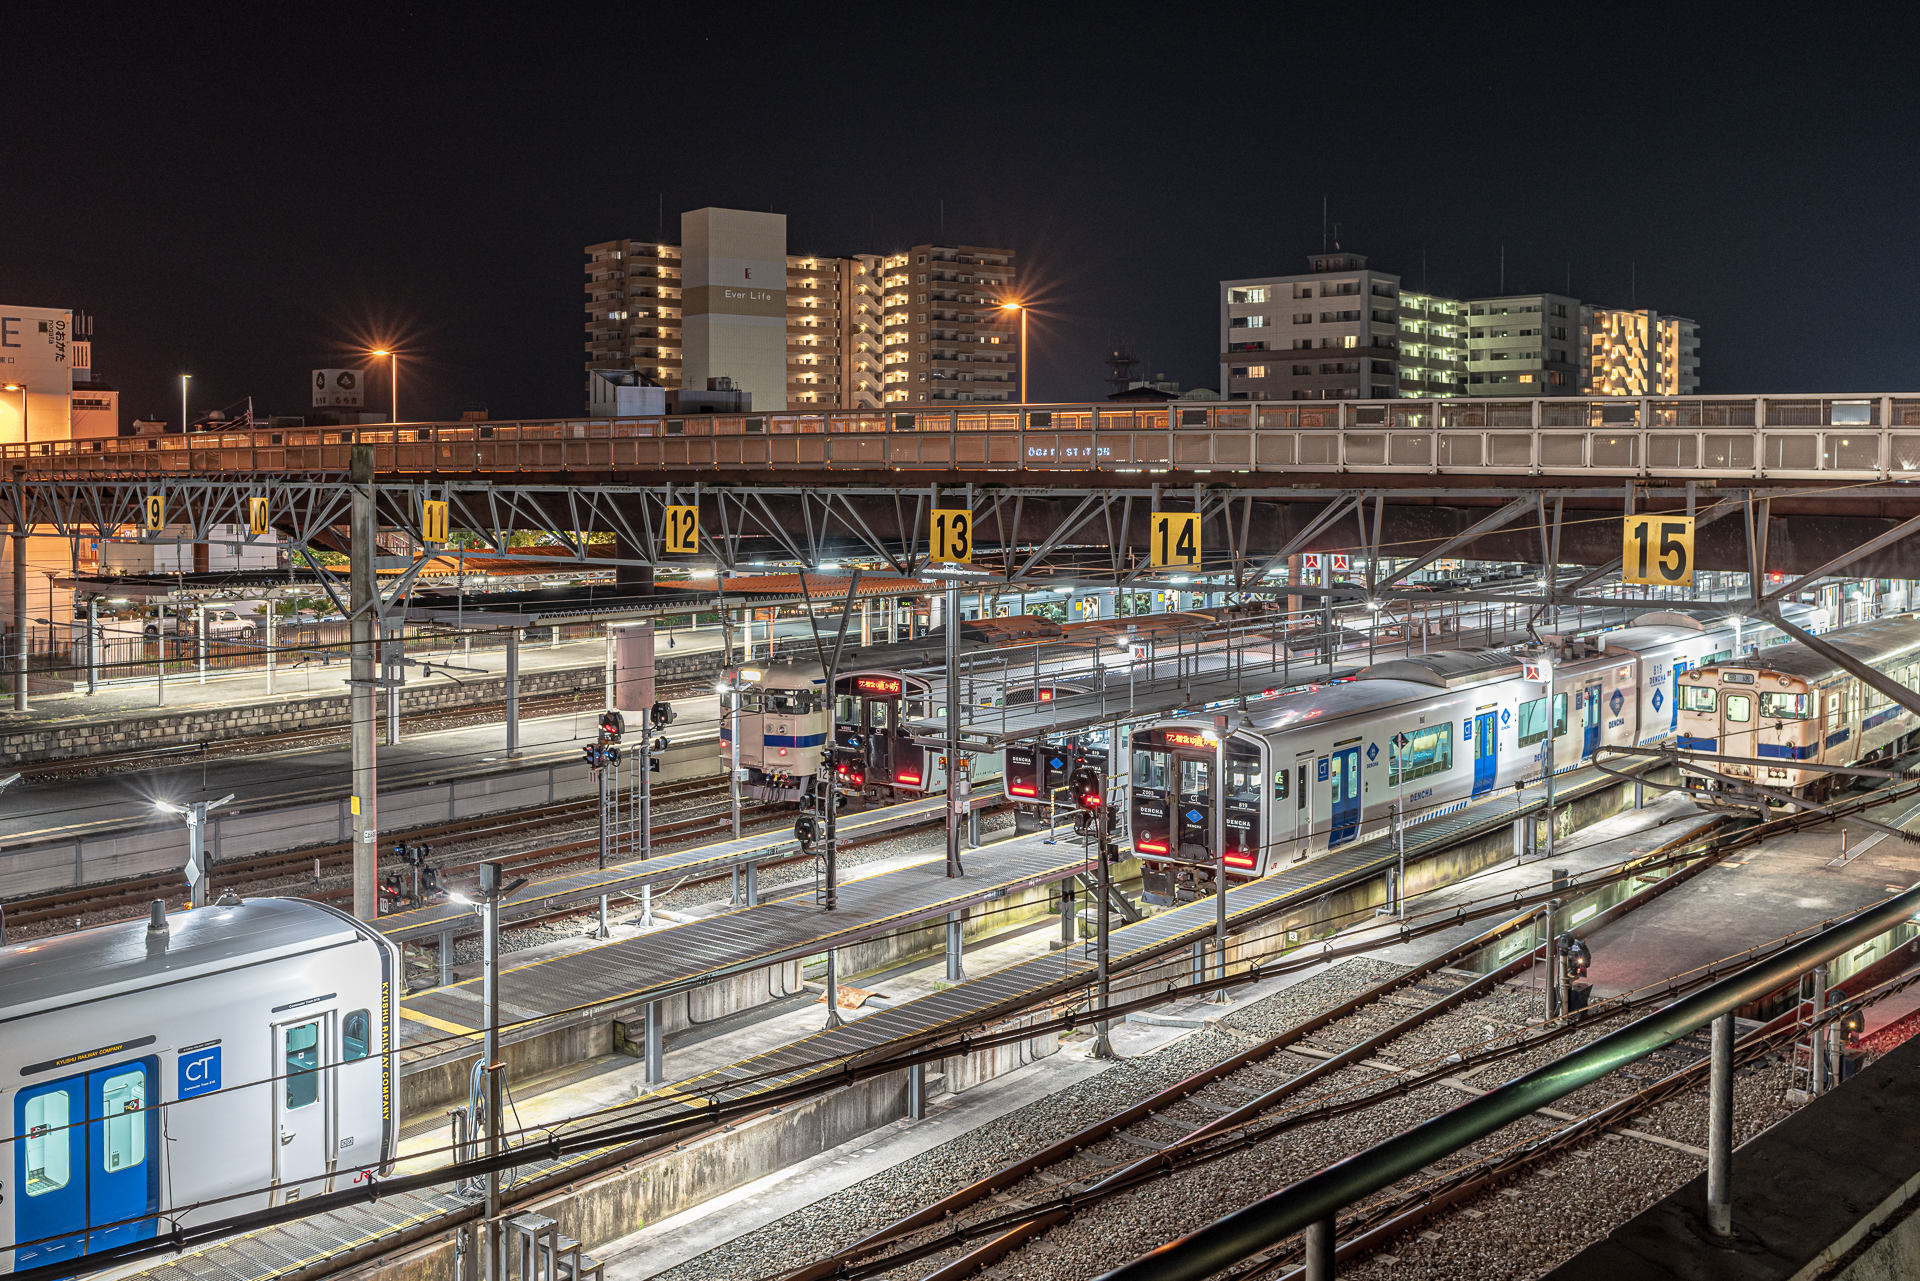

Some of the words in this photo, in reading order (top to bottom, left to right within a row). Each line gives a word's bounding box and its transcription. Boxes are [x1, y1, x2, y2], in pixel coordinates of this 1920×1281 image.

[725, 290, 746, 299] Ever
[750, 291, 771, 301] Life
[55, 320, 66, 362] のおがた
[150, 499, 160, 527] 9
[254, 500, 267, 531] 10
[427, 504, 446, 539] 11
[671, 510, 695, 549] 12
[936, 514, 968, 559] 13
[1158, 518, 1197, 565] 14
[1634, 521, 1687, 581] 15
[1608, 718, 1625, 729] DENCHA
[818, 768, 828, 780] 12
[1238, 801, 1248, 809] 819
[1410, 788, 1433, 803] DENCHA
[1140, 806, 1164, 815] DENCHA
[1226, 818, 1251, 828] DENCHA
[1270, 862, 1278, 870] JR
[1291, 932, 1297, 940] 3
[382, 982, 390, 1023] KYUSHU
[56, 1057, 77, 1066] KYUSHU
[77, 1051, 99, 1060] RAILWAY
[98, 1045, 123, 1055] COMPANY
[382, 1025, 390, 1069] RAILWAY
[186, 1056, 214, 1081] CT
[382, 1071, 390, 1121] COMPANY
